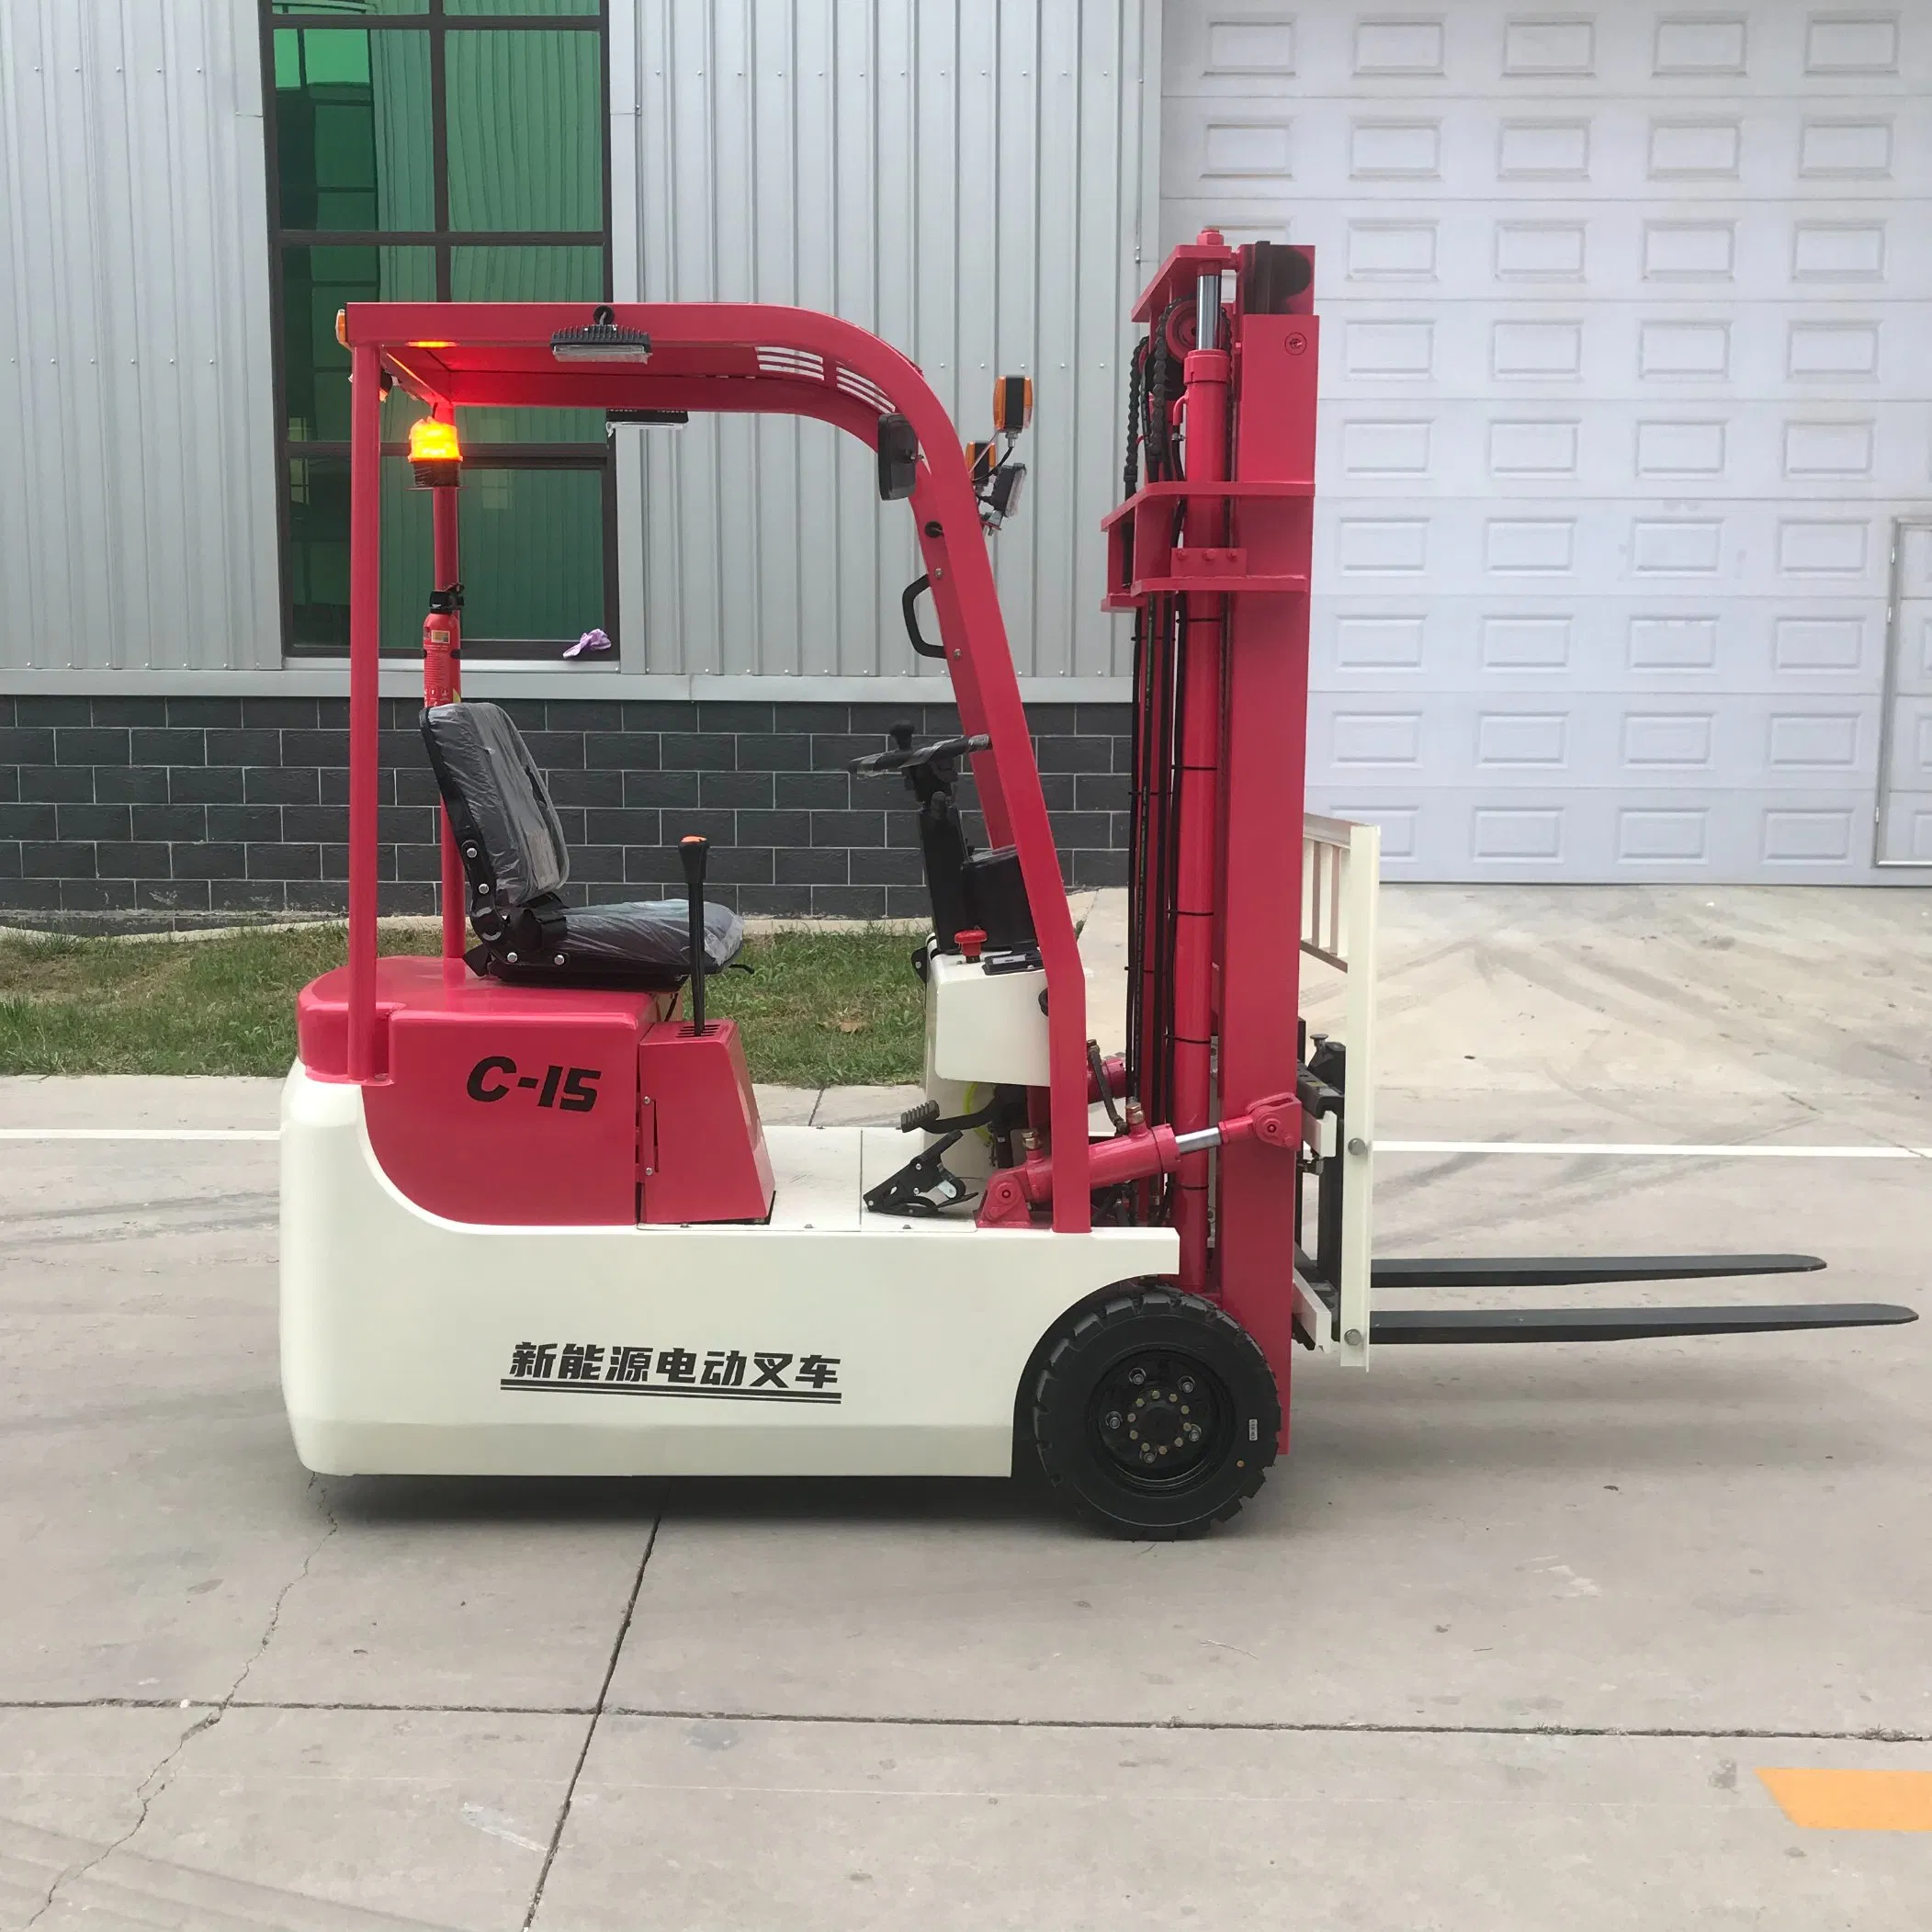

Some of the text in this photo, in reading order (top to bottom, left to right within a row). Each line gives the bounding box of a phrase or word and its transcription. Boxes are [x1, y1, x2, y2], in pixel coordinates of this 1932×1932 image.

[467, 1056, 602, 1113] C-15
[509, 1341, 841, 1389] 新能源电动叉车
